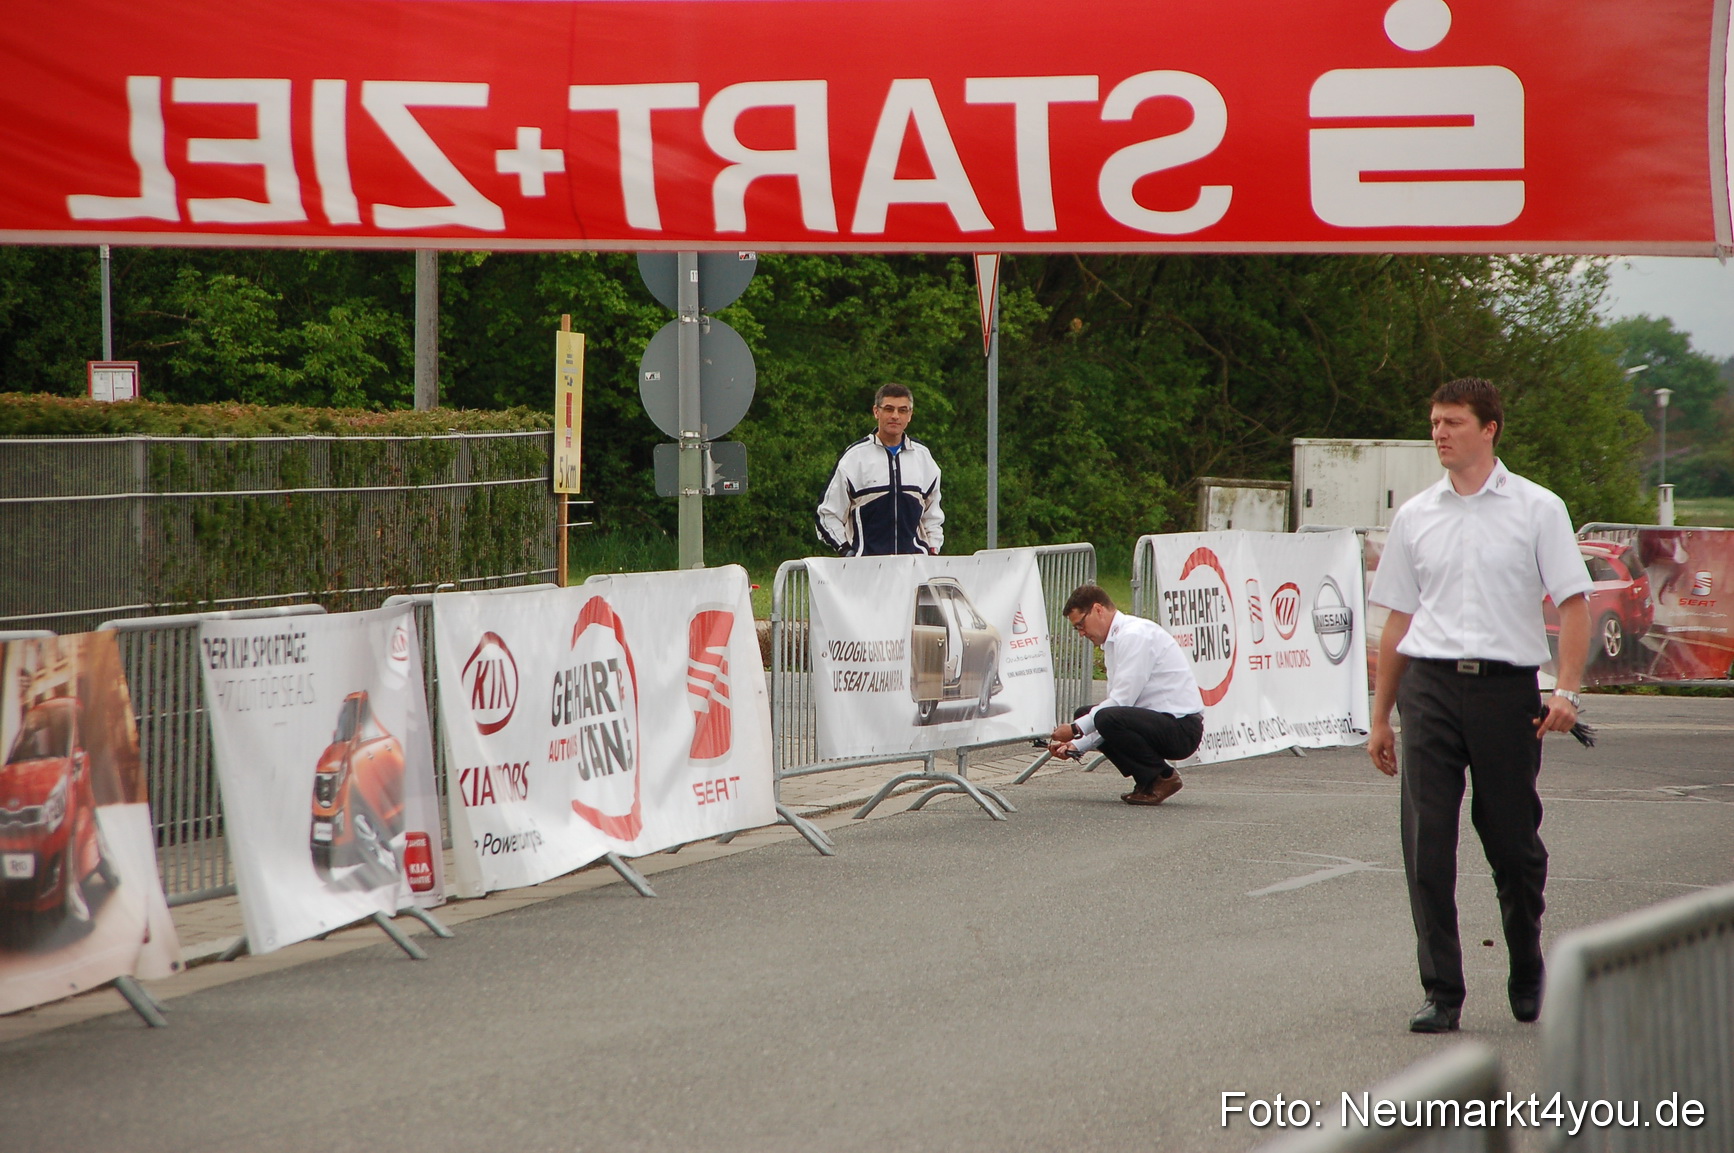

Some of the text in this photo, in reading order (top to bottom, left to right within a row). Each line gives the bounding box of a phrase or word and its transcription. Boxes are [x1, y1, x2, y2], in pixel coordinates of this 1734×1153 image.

[558, 454, 577, 489] 5 km
[1679, 598, 1717, 607] SEAT
[1315, 612, 1348, 628] NISSAN
[1010, 636, 1039, 650] SEAT
[472, 659, 511, 710] KIA
[843, 670, 871, 692] SEAT
[551, 658, 624, 728] GEHART
[692, 776, 741, 806] SEAT
[409, 863, 431, 874] KIA
